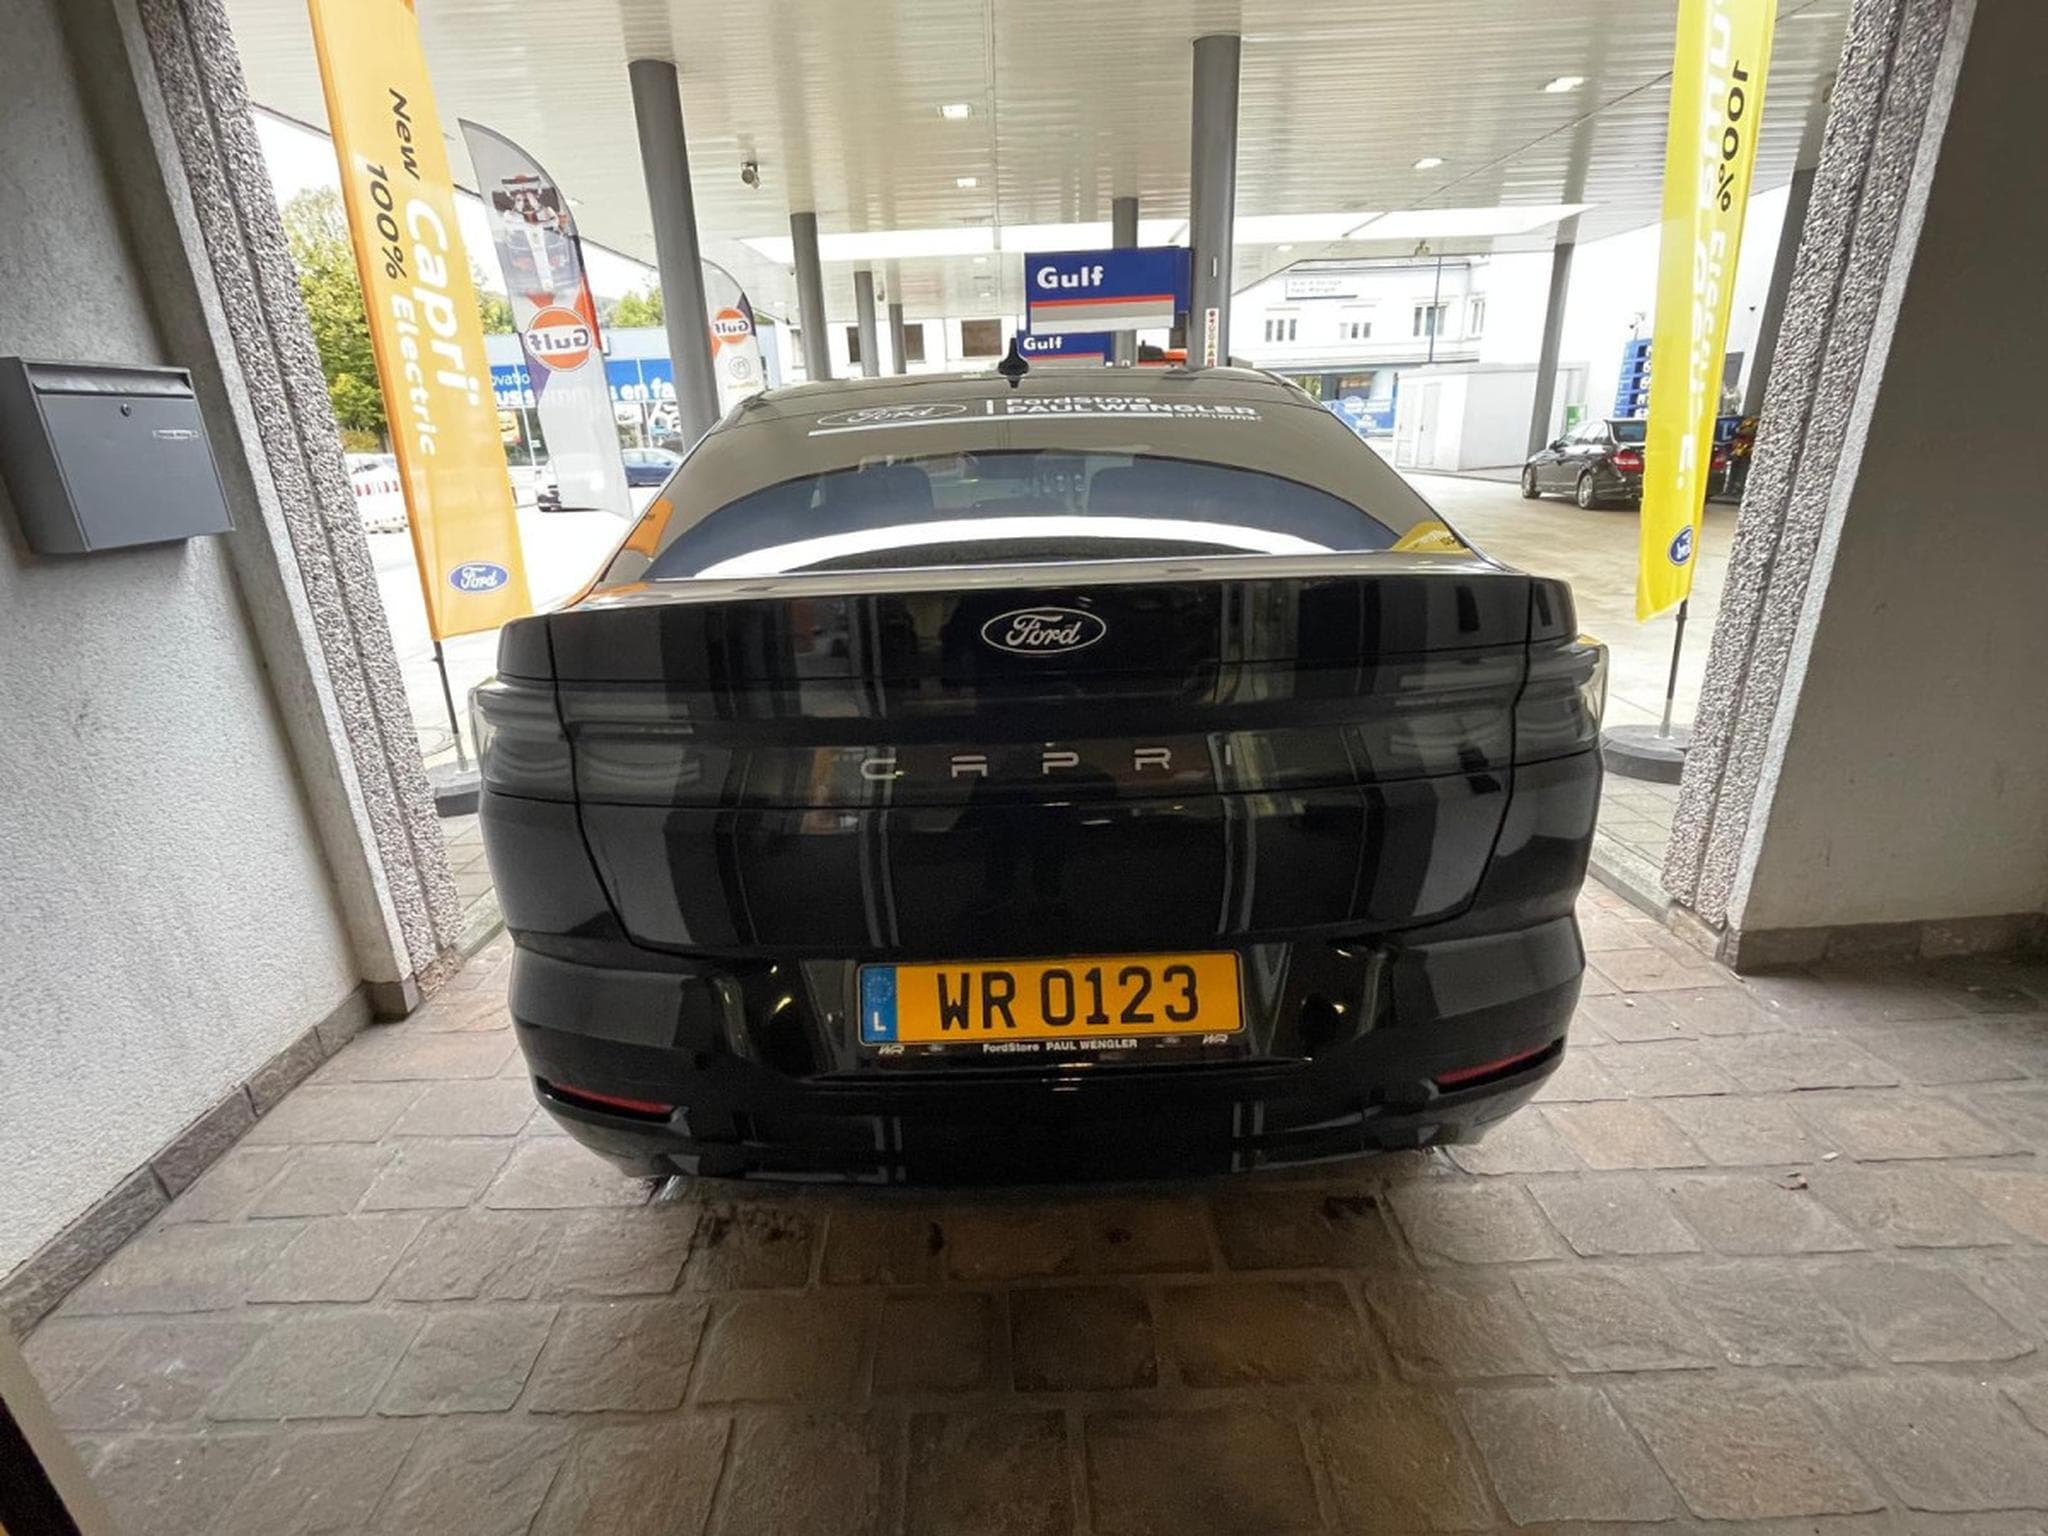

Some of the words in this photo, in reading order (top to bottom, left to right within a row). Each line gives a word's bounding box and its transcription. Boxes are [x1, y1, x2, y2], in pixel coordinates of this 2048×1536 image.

[388, 87, 421, 181] New
[366, 163, 408, 280] 100%
[1036, 266, 1104, 289] Gulf
[1023, 336, 1063, 350] Gulf
[391, 294, 438, 456] Electric
[1006, 403, 1093, 414] PAUL
[1098, 402, 1256, 415] WENGLER
[460, 566, 498, 589] Ford
[1005, 613, 1082, 646] Ford
[873, 1011, 887, 1032] L
[937, 971, 1017, 1031] WR
[1040, 964, 1199, 1027] 0123
[983, 1043, 1040, 1053] FordStore
[1045, 1040, 1077, 1051] PAUL
[1080, 1038, 1138, 1050] WENGLER
